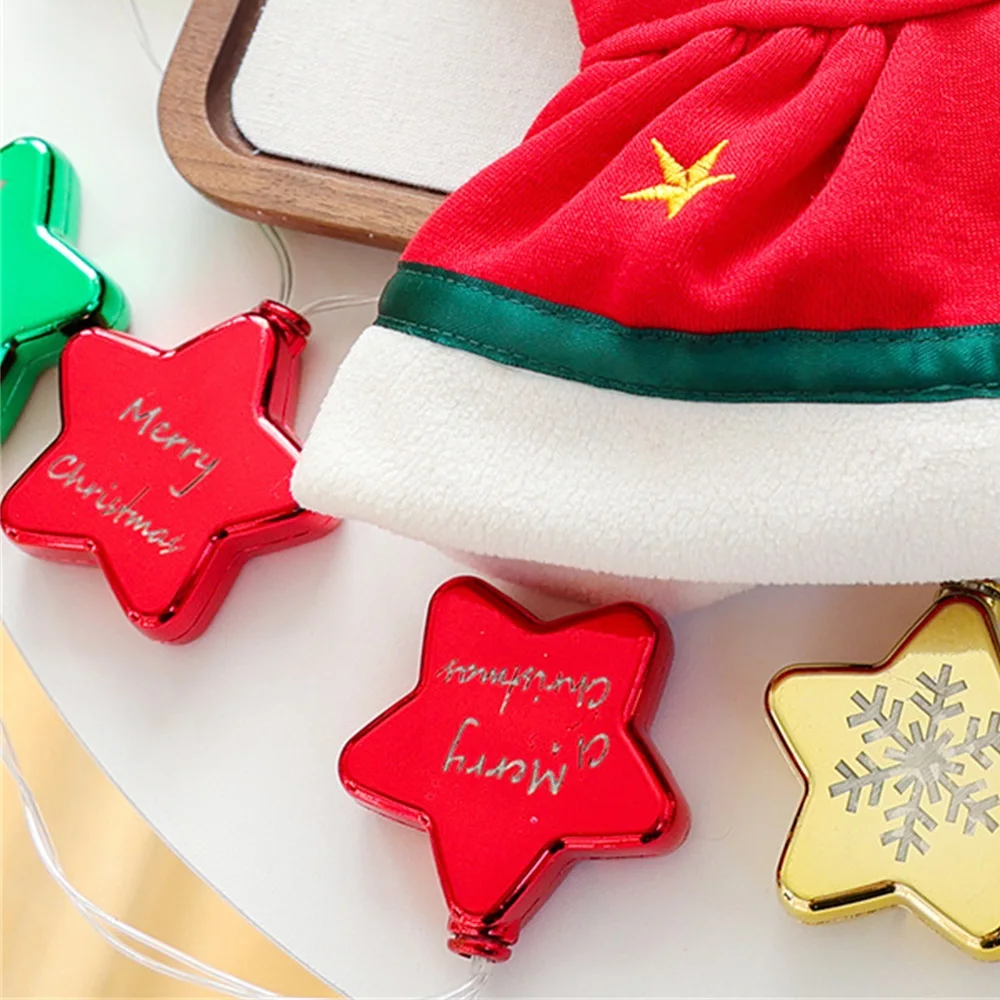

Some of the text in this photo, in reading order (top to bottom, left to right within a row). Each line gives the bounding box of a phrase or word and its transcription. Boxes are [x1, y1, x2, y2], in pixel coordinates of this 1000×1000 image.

[119, 397, 219, 497] Merry
[48, 454, 184, 555] Christmas
[436, 659, 611, 714] Christmas
[443, 717, 567, 795] Merry
